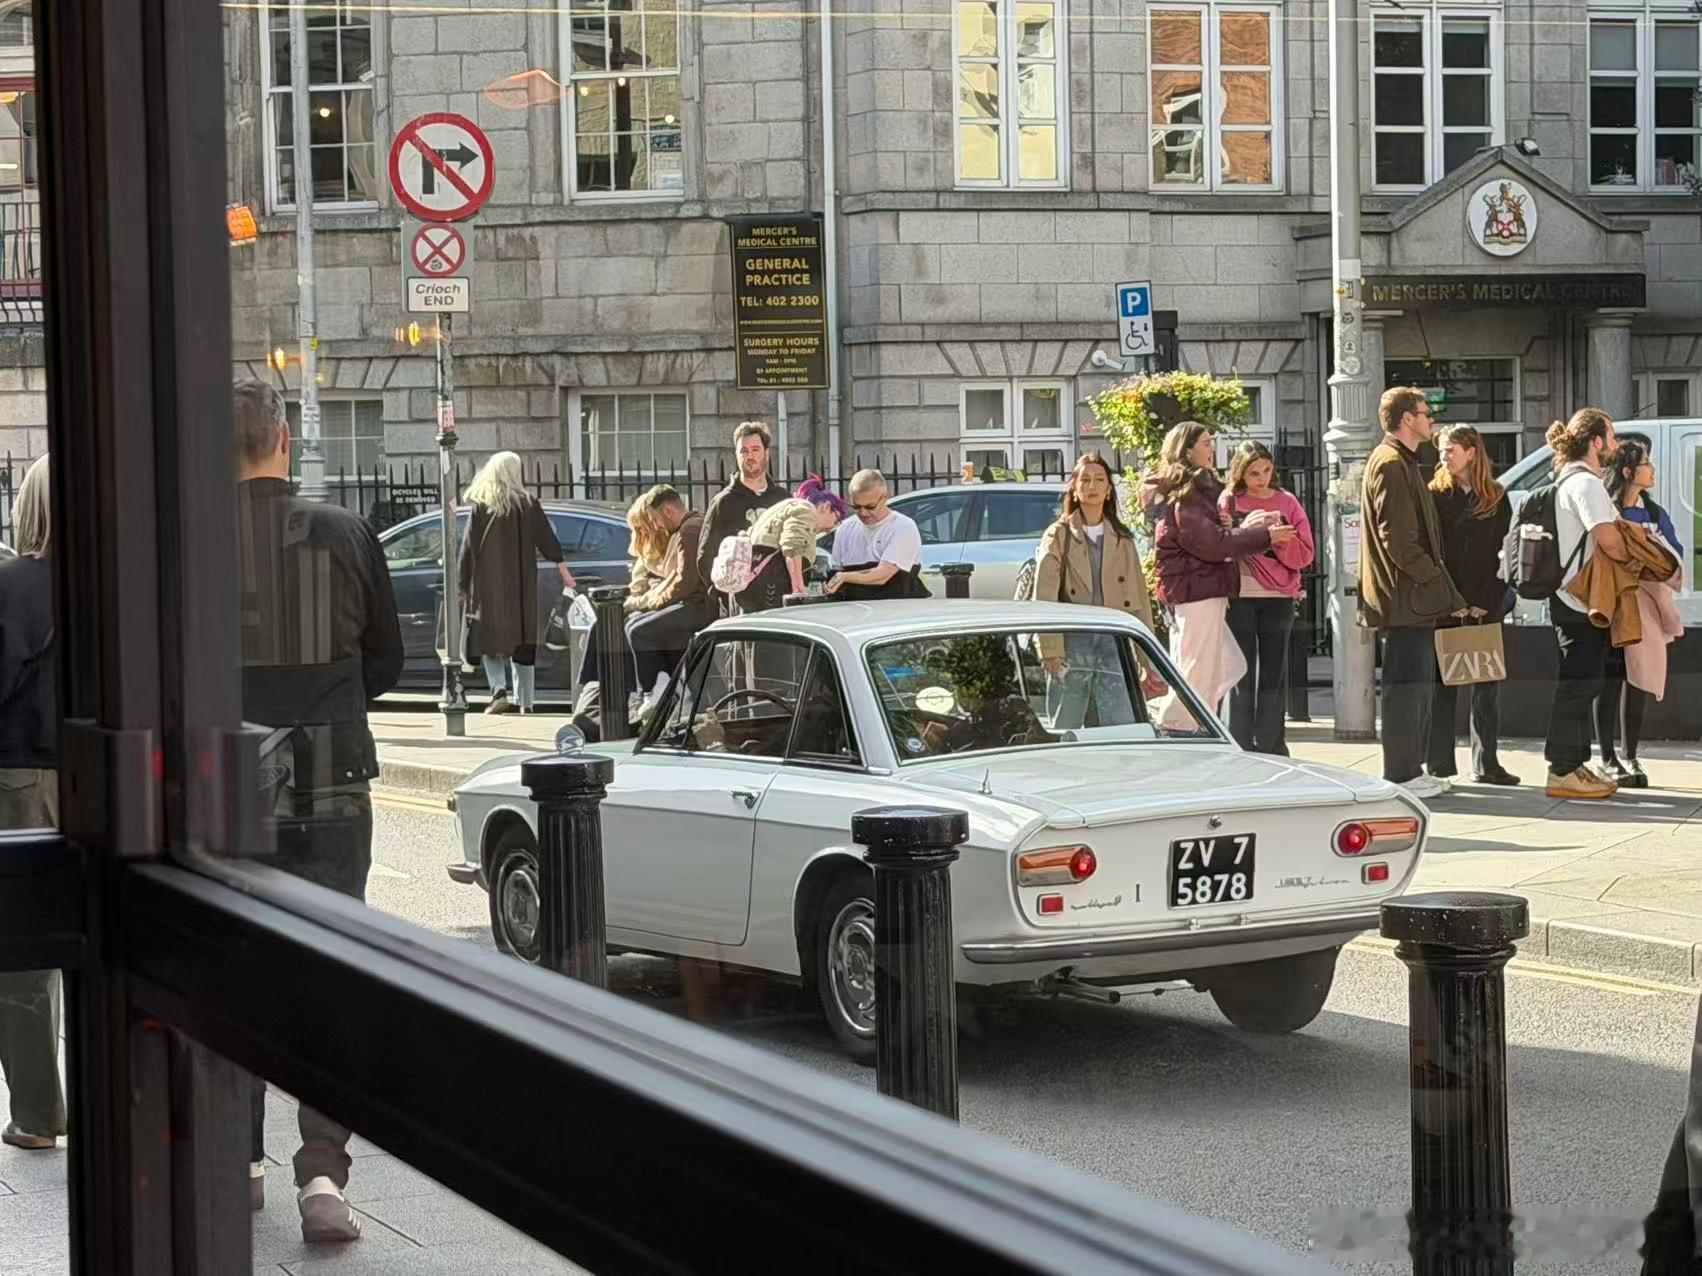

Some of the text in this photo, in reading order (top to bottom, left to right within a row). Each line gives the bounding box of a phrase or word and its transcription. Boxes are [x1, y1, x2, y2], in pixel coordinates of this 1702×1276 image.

[751, 226, 798, 236] MERCER'S
[737, 236, 817, 247] MEDICAL CENTRE
[745, 257, 809, 271] GENERAL
[745, 273, 811, 287] PRACTICE
[1372, 283, 1466, 301] MERCER'S
[1472, 282, 1554, 300] MEDICAL
[424, 295, 454, 306] END
[740, 295, 820, 307] TEL: 402 2300
[1126, 291, 1142, 314] P
[743, 337, 820, 347] SURGERY HOURS
[790, 347, 817, 355] FRIDAY
[1442, 650, 1506, 681] ZARA
[1178, 836, 1249, 870] ZV 7
[1176, 872, 1247, 905] 5878
